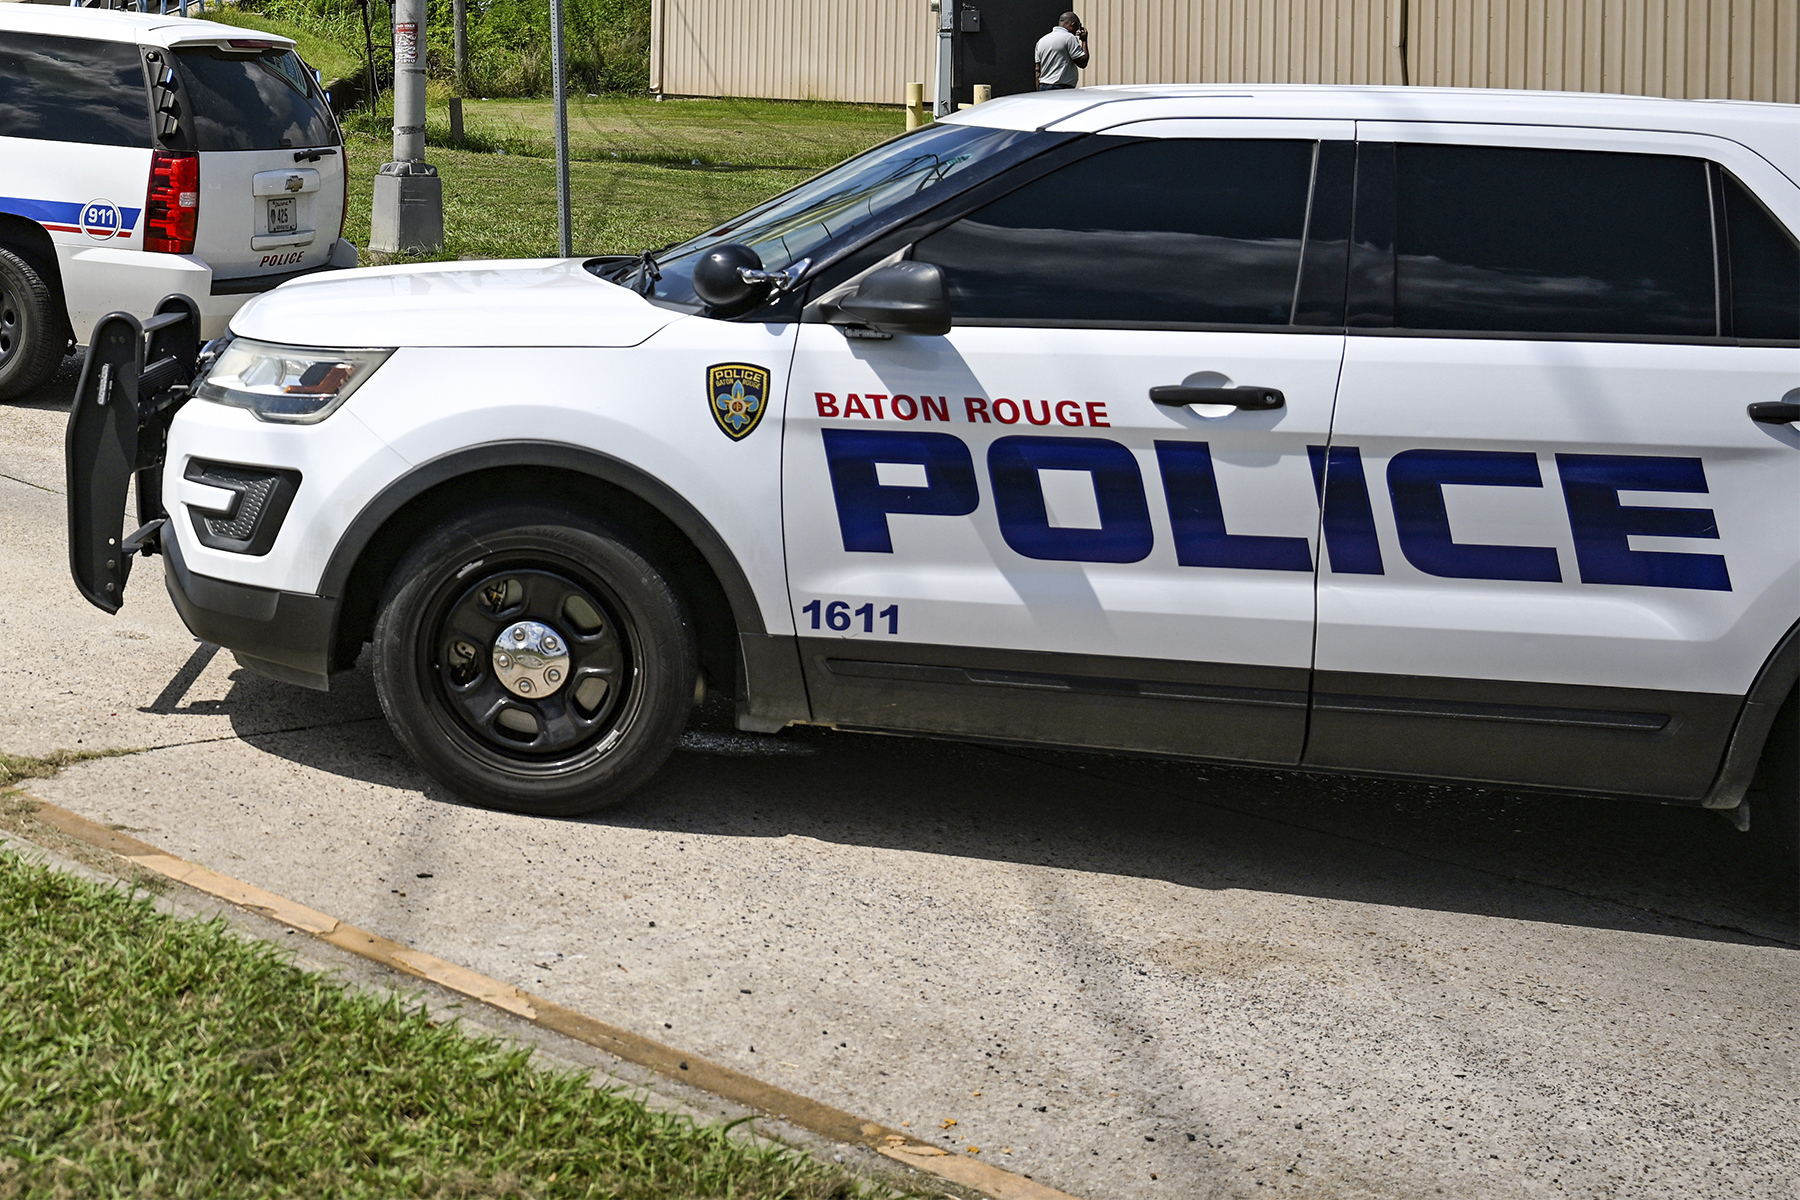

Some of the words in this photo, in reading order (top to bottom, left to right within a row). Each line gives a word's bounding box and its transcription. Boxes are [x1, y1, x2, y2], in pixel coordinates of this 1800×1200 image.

[87, 207, 114, 225] 911
[277, 208, 289, 223] 425
[259, 251, 304, 268] POLICE
[715, 369, 762, 382] POLICE
[715, 379, 733, 387] BATON
[814, 392, 950, 422] BATON
[964, 396, 1111, 428] ROUGE
[820, 428, 1732, 591] POLICE
[802, 599, 899, 635] 1611
